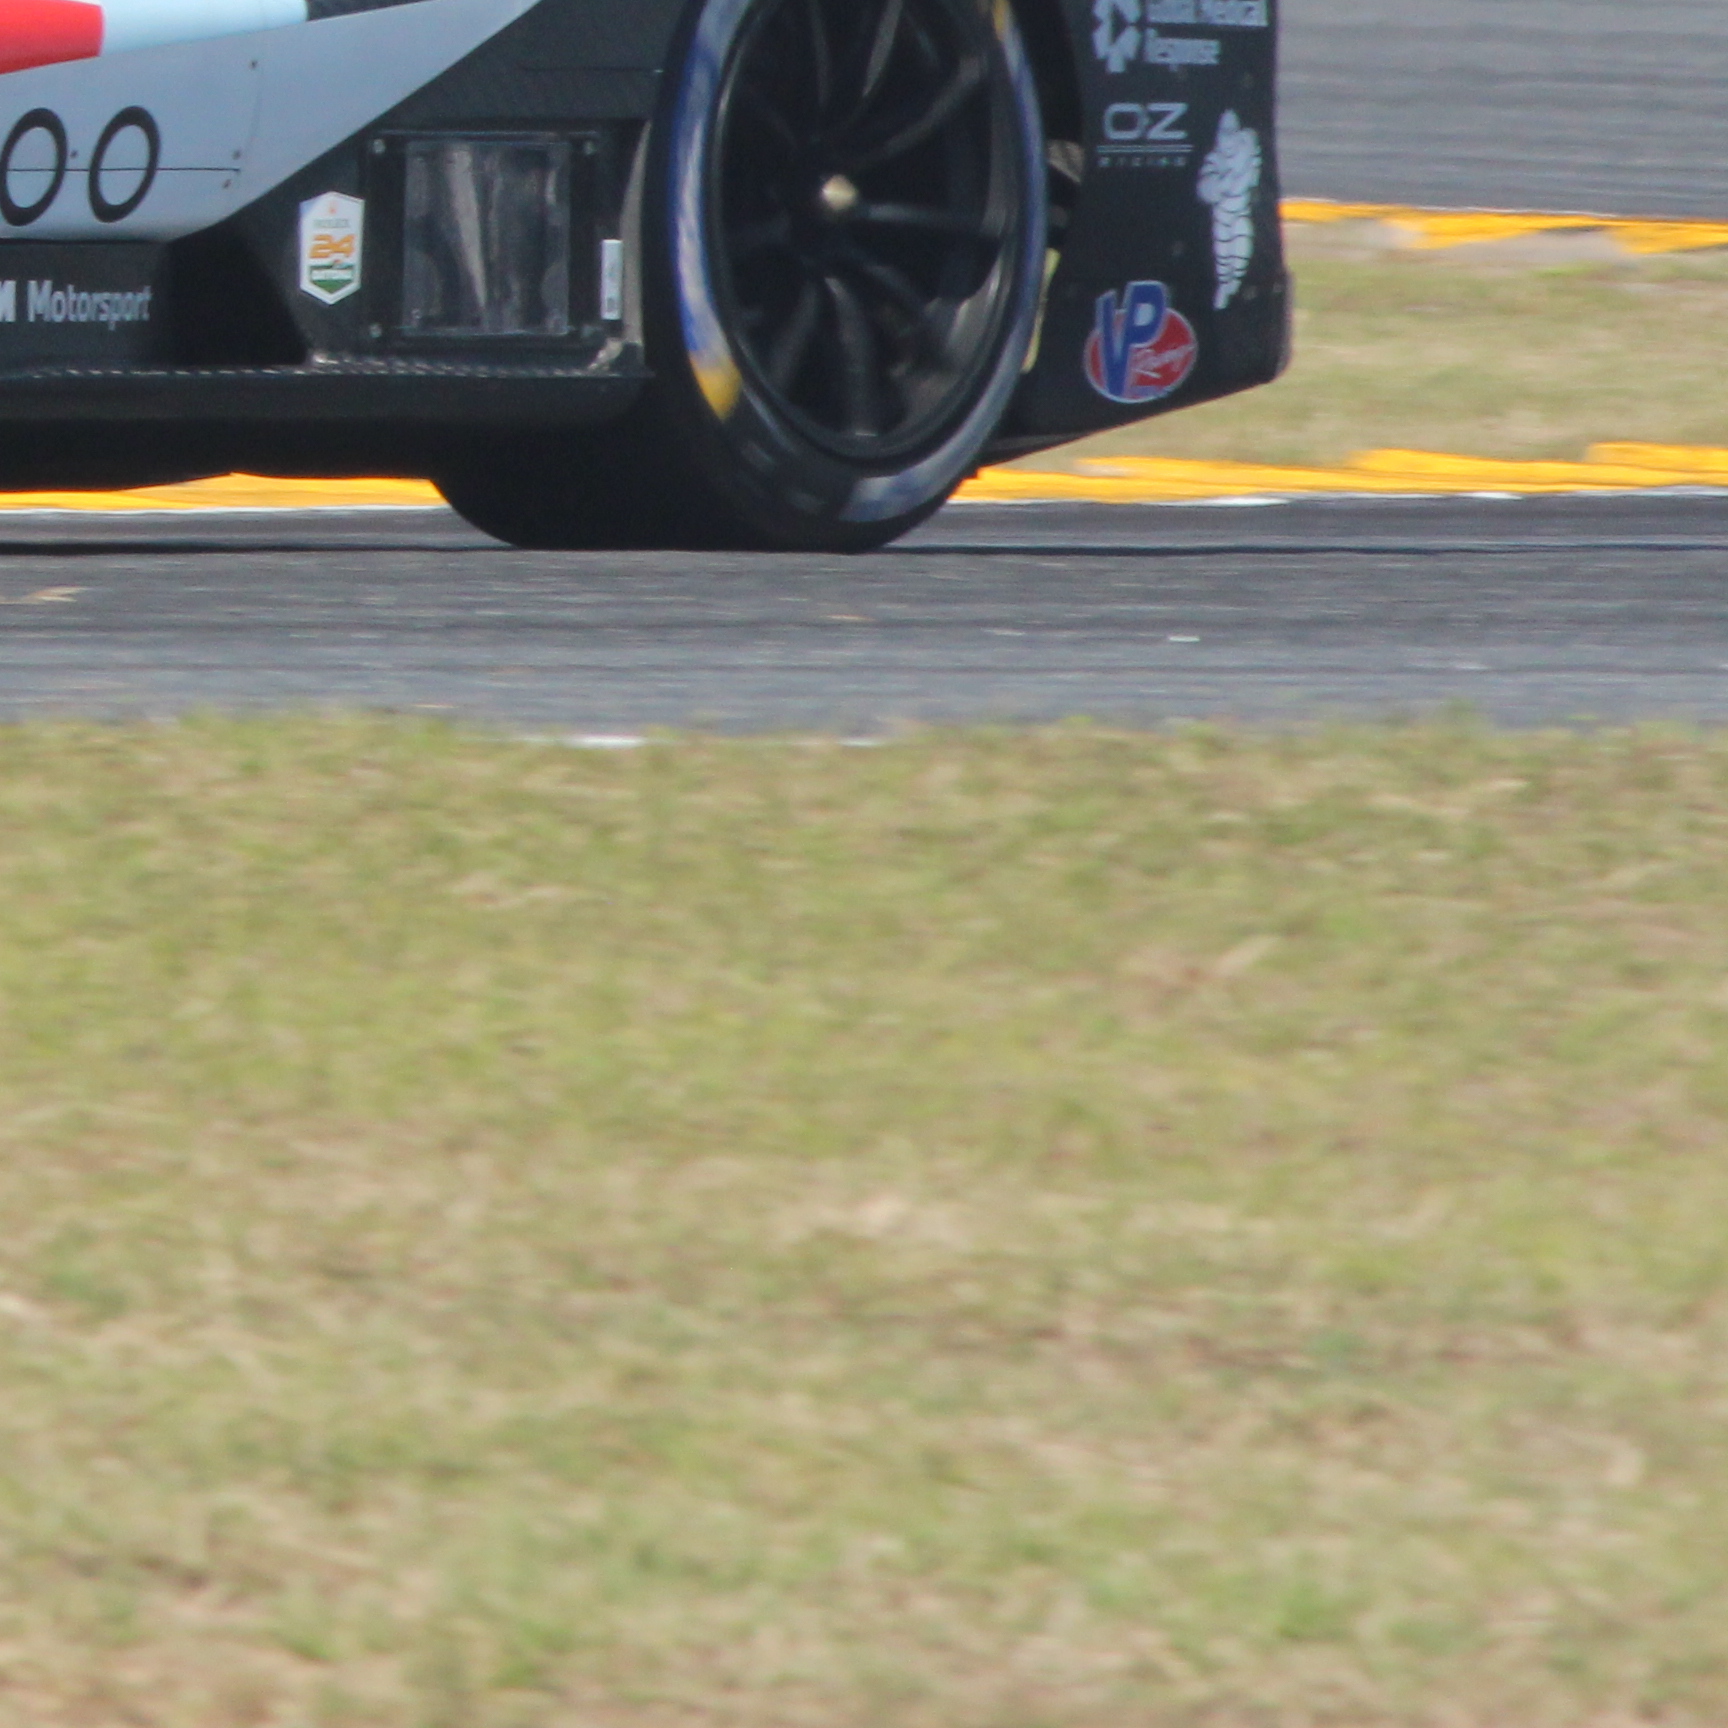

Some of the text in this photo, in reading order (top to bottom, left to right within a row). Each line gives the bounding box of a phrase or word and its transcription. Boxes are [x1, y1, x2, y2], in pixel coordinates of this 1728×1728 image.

[1104, 102, 1189, 141] OZ
[27, 280, 152, 332] Motorsport
[1095, 280, 1171, 398] VP
